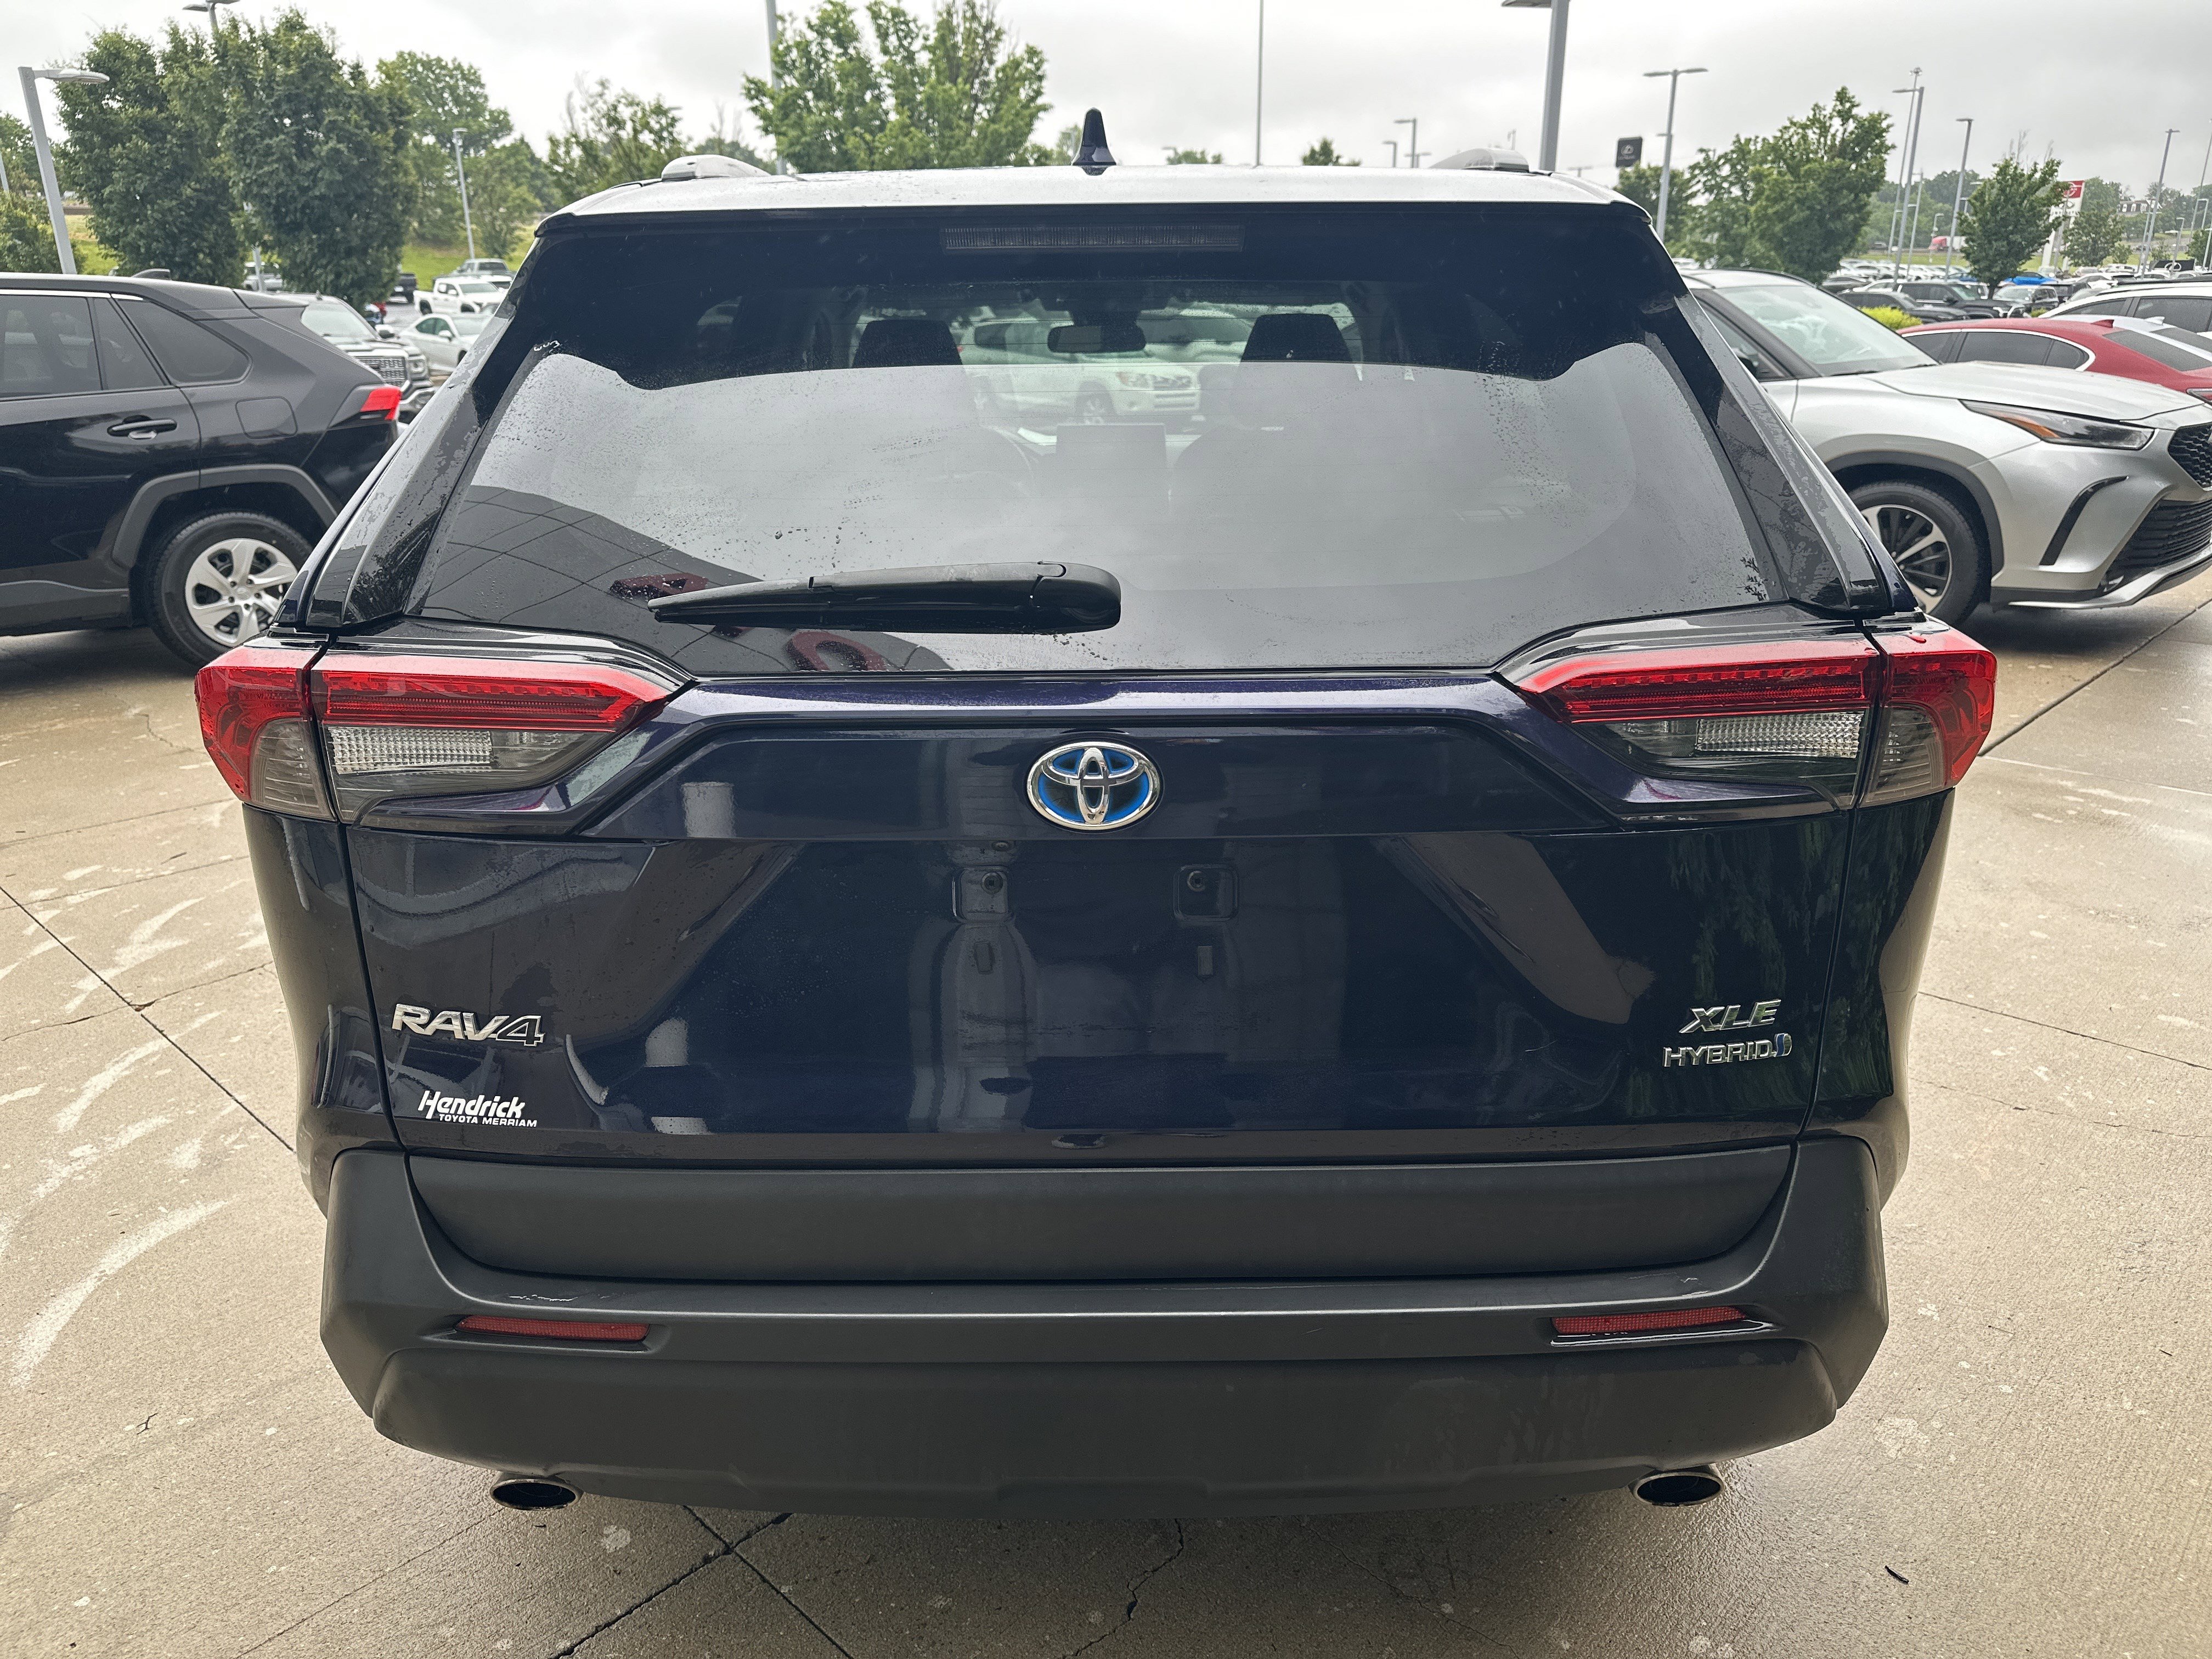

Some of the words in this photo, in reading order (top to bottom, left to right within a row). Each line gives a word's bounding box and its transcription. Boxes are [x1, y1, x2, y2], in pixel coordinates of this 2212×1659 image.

[391, 1003, 545, 1046] RAV4
[1679, 998, 1781, 1034] XLE
[1663, 1040, 1773, 1066] HYBRID
[417, 1090, 526, 1119] Hendrick
[439, 1114, 478, 1125] TOYOTA
[482, 1116, 537, 1127] MERRIAM
